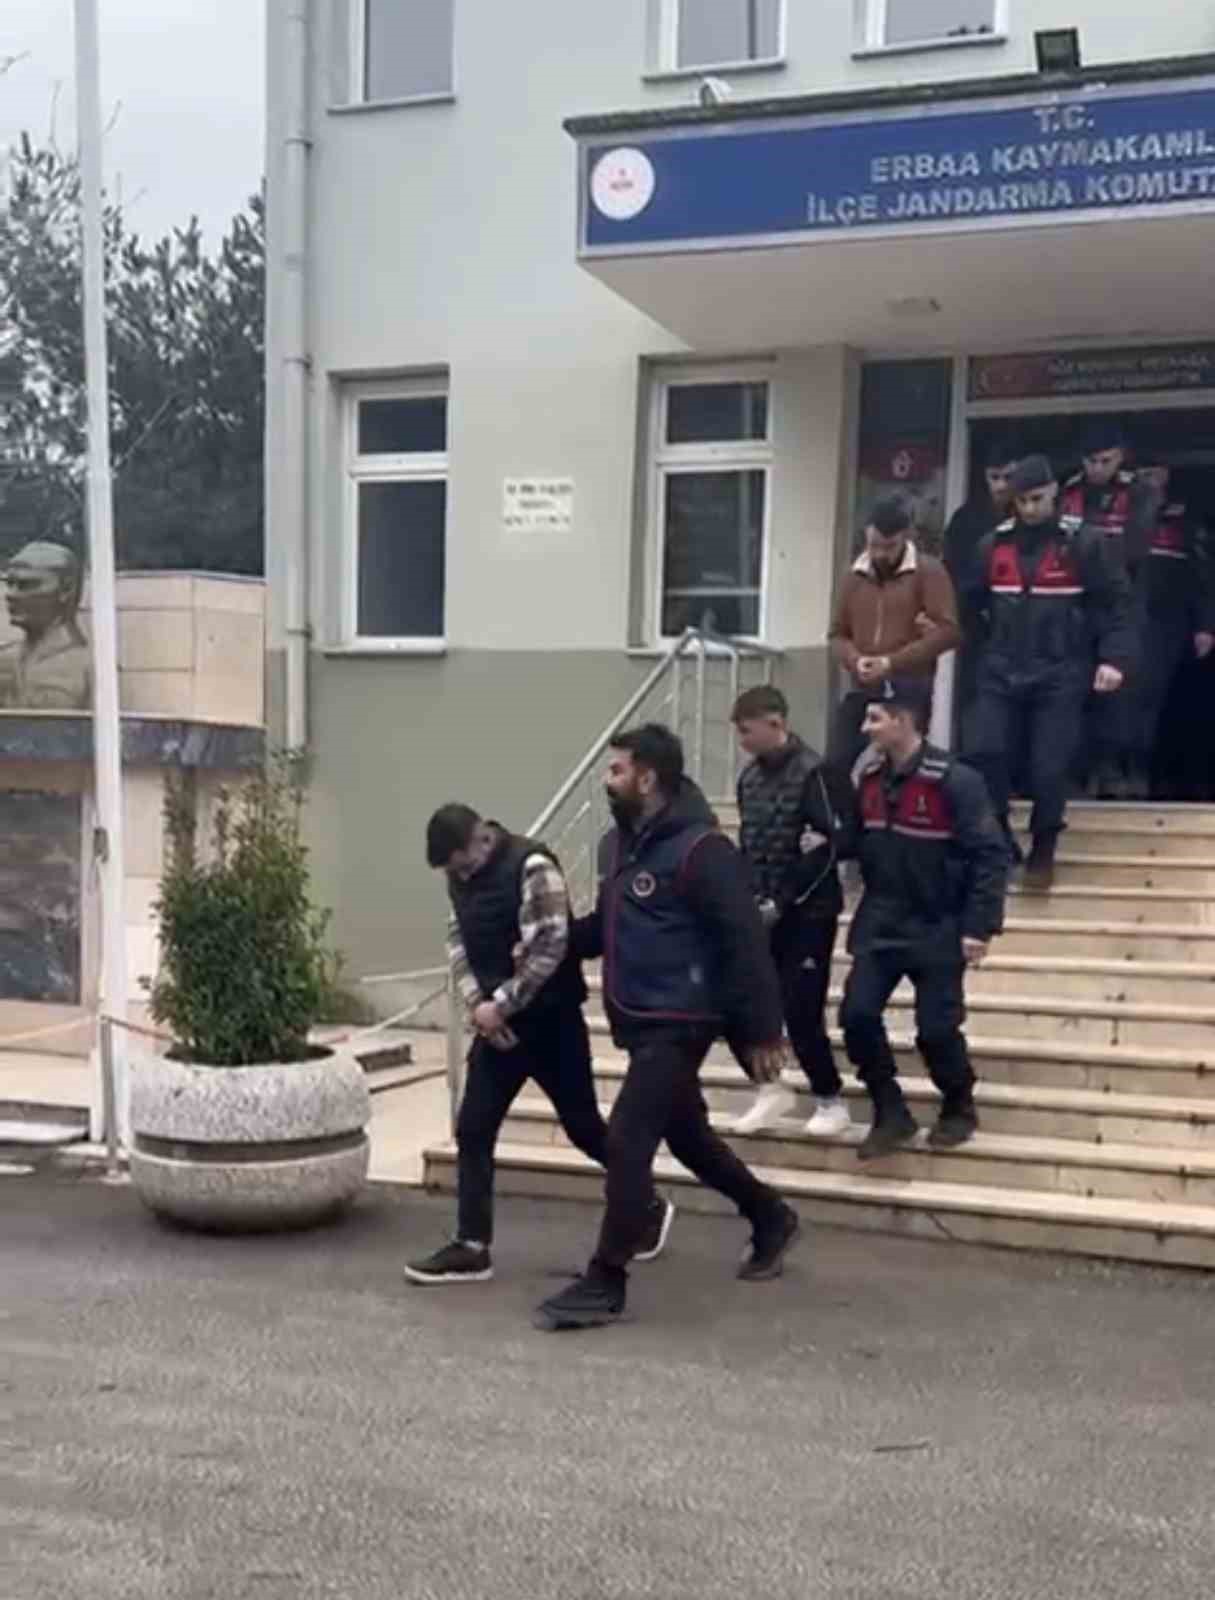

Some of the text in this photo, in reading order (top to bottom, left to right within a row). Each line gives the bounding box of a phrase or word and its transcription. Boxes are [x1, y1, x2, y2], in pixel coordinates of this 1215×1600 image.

[1033, 105, 1095, 133] T.C.
[870, 151, 981, 184] ERBAA
[806, 190, 878, 226] İLÇE
[887, 180, 1073, 218] JANDARMA
